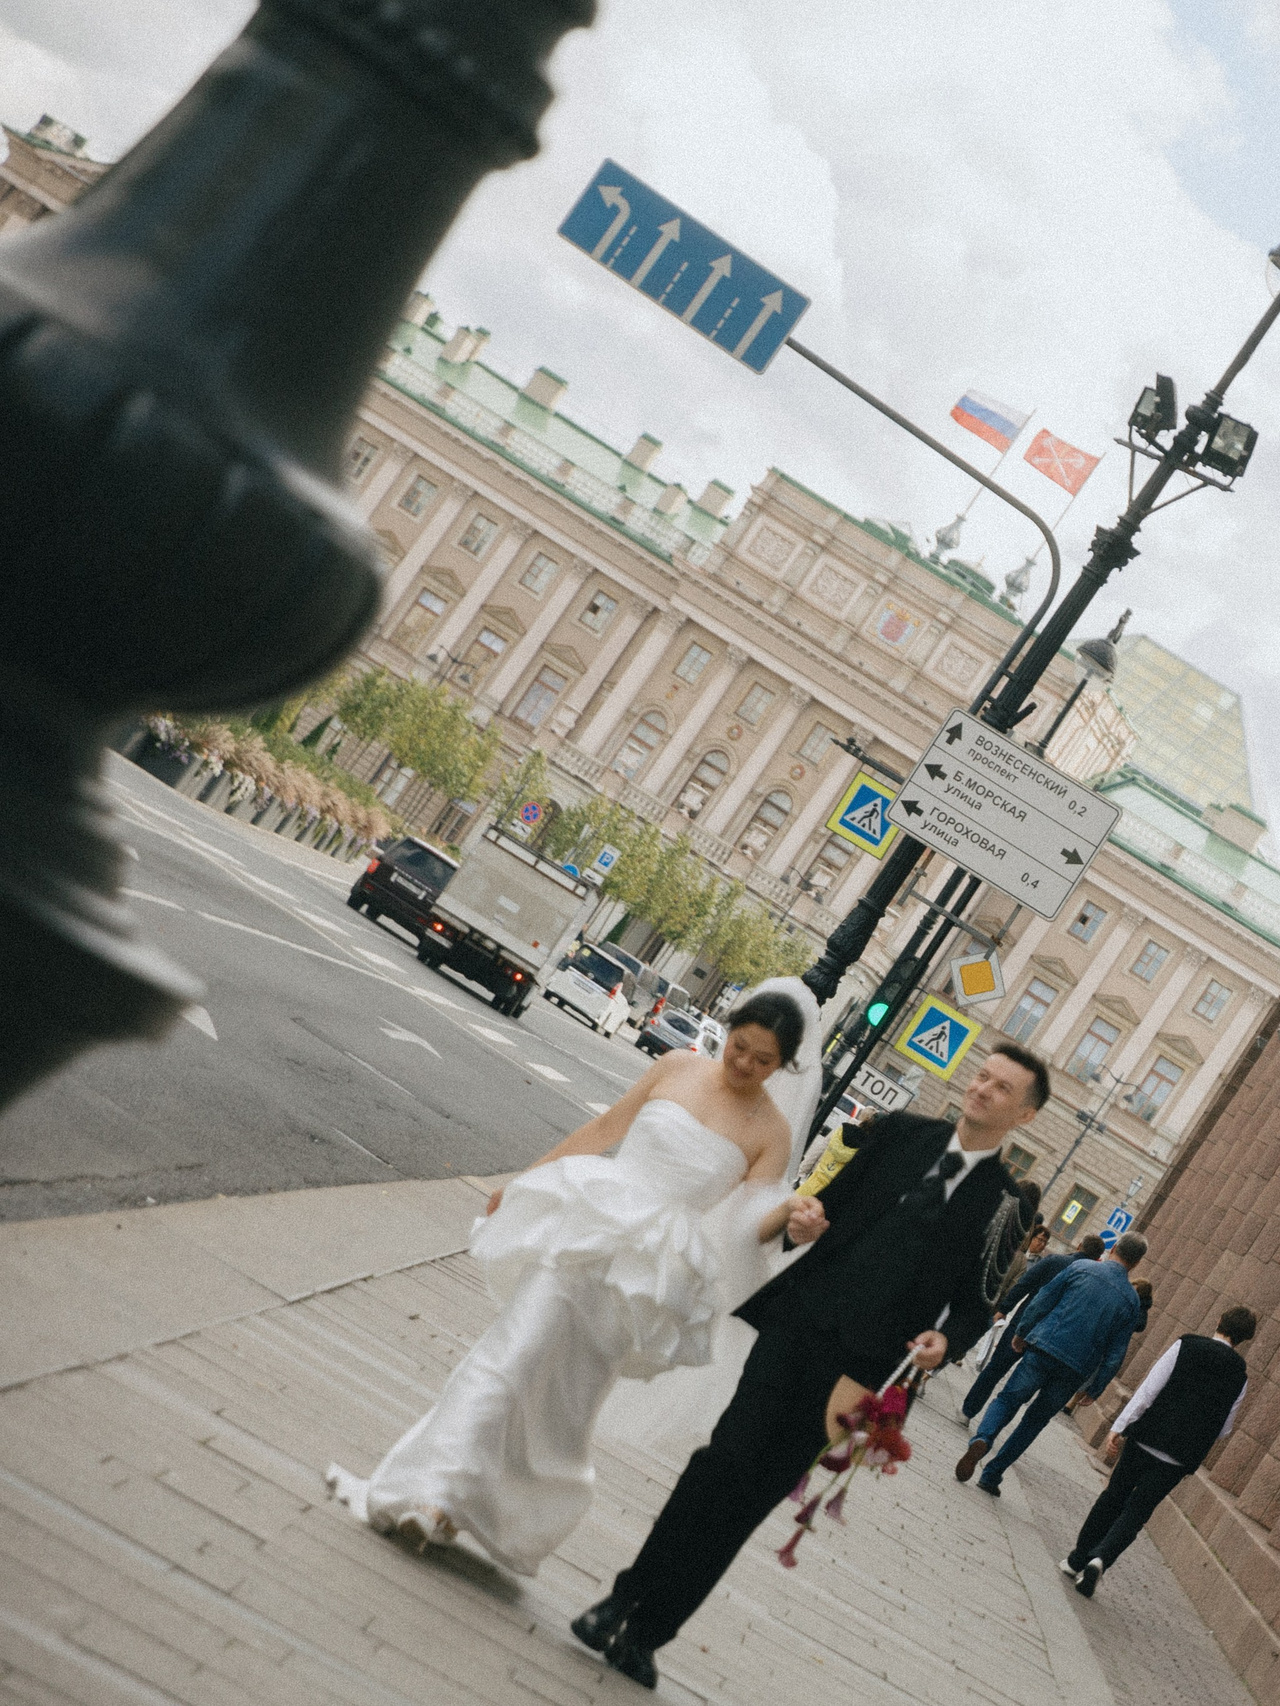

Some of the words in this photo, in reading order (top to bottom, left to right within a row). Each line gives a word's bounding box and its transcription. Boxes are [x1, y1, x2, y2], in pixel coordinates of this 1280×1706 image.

[967, 748, 1019, 784] проспект
[974, 735, 1068, 799] ВОЗНЕСЕНСКИЙ
[1068, 799, 1087, 818] 0,2
[944, 783, 983, 812] улица
[952, 770, 1028, 823] Б.МОРСКАЯ
[920, 819, 960, 848] улица
[929, 806, 1007, 860] ГОРОХОВАЯ
[1020, 872, 1040, 890] 0,4
[855, 1067, 899, 1106] ТОП
